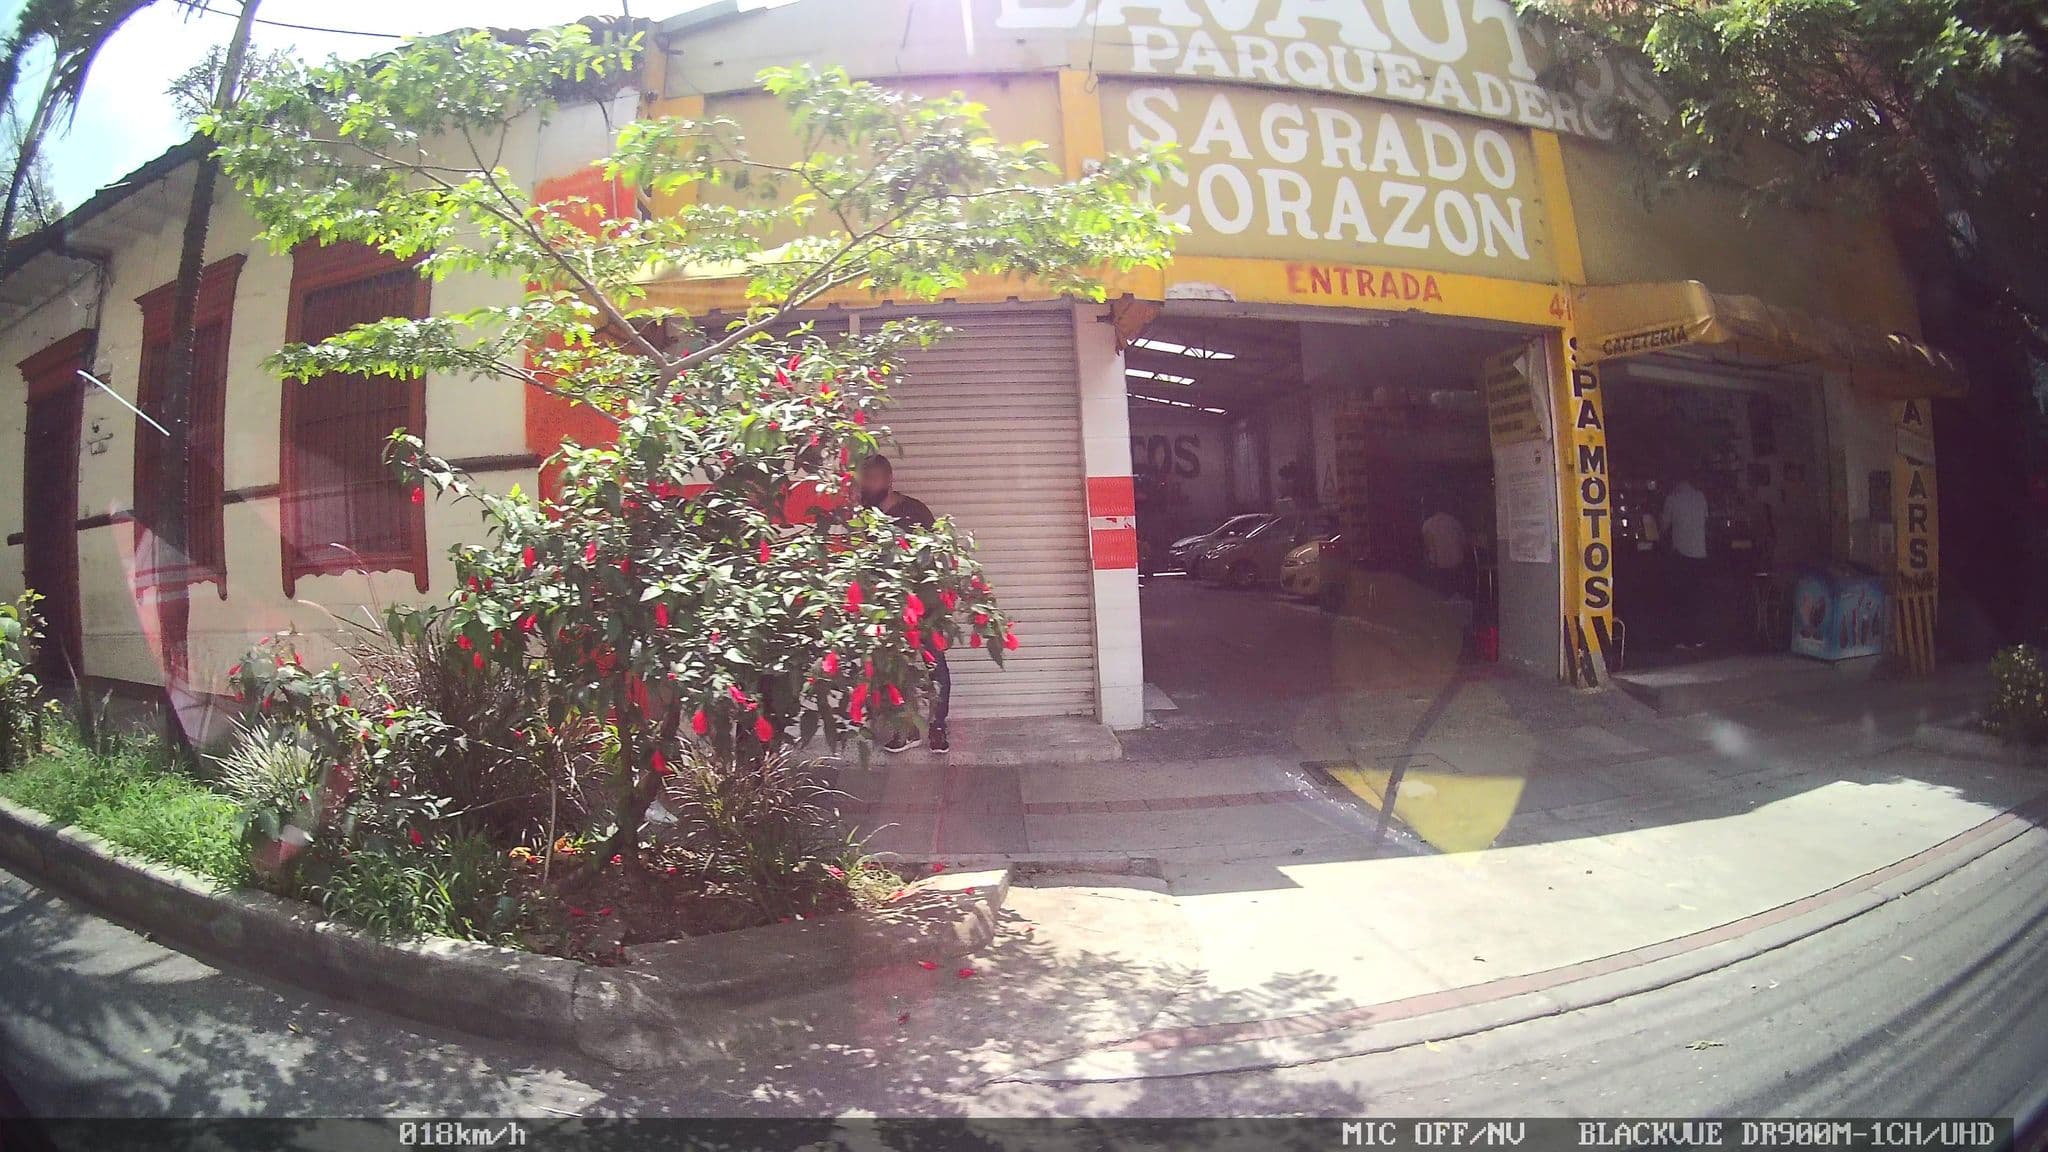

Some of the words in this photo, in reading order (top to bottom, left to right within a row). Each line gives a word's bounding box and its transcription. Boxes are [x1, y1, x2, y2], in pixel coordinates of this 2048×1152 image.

[1126, 88, 1517, 189] SAGRADO
[1138, 155, 1531, 261] CORAZON
[1287, 263, 1444, 303] ENTRADA
[1602, 324, 1690, 356] CAFETERIA
[1577, 444, 1611, 609] MOTOS
[1906, 455, 1929, 569] ARS
